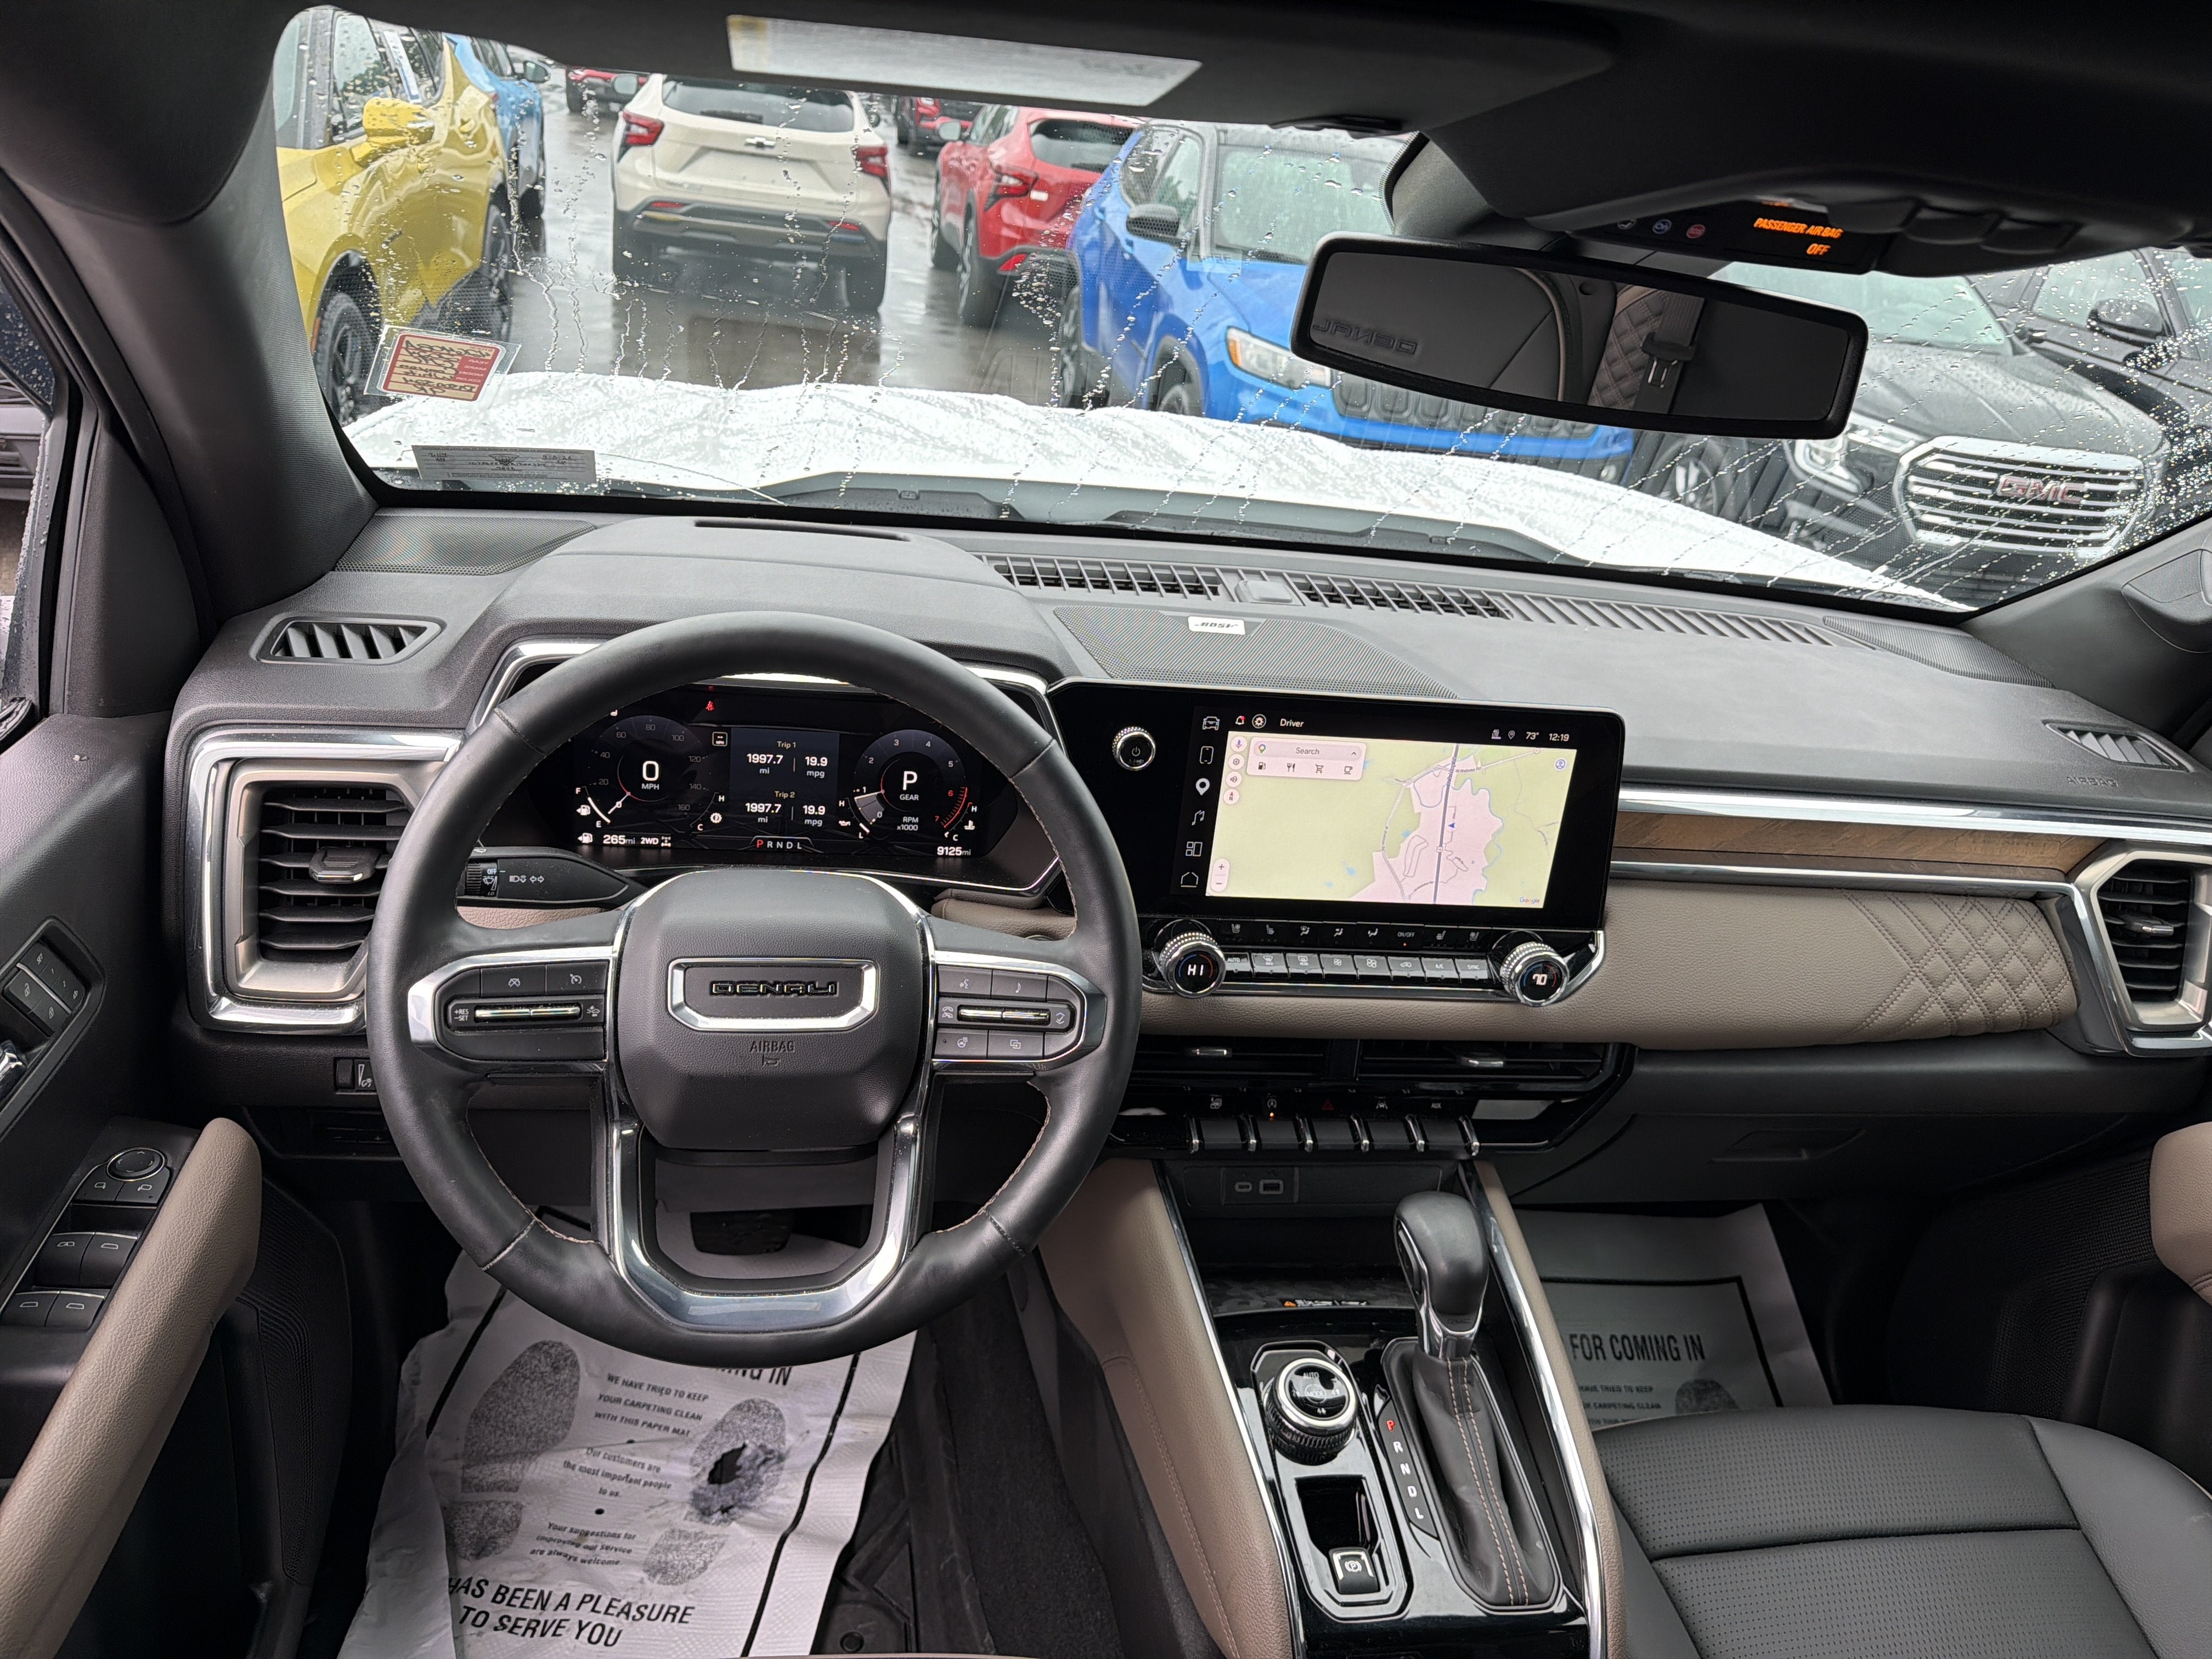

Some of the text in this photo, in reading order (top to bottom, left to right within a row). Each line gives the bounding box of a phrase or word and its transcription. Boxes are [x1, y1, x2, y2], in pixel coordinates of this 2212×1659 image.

[1754, 218, 1808, 233] PASSENGER
[1807, 243, 1831, 256] OFF
[1997, 476, 2089, 503] GMC
[1280, 718, 1304, 728] Driver
[1526, 731, 1539, 740] 73°
[1549, 733, 1570, 742] 12:19
[1295, 747, 1320, 755] Search
[747, 753, 783, 764] 1997.7
[805, 757, 828, 766] 19.9
[642, 761, 659, 781] 0
[806, 770, 825, 778] mpg
[902, 771, 918, 791] P
[2067, 776, 2119, 787] AIRBAG
[774, 791, 788, 799] Trip
[745, 803, 782, 813] 1997.7
[803, 805, 826, 815] 19.9
[804, 819, 823, 827] mpg
[757, 839, 763, 848] P
[1187, 964, 1204, 975] HI
[1532, 974, 1547, 985] 70
[710, 981, 838, 996] DENALI
[749, 1041, 795, 1053] AIRBAG
[1570, 1333, 1705, 1361] FOR COMING IN
[769, 1367, 793, 1386] IN
[607, 1373, 709, 1402] WE HAVE TRIED TO KEEP
[597, 1393, 703, 1421] YOUR CARPETING CLEAN
[594, 1412, 691, 1437] WITH THIS PAPER MAT
[1386, 1420, 1395, 1431] P
[1393, 1441, 1403, 1453] R
[586, 1447, 662, 1473] Our customers are
[563, 1460, 672, 1490] the most important people
[1400, 1463, 1411, 1475] N
[598, 1487, 607, 1495] to
[1407, 1486, 1417, 1497] D
[1415, 1508, 1424, 1519] L
[548, 1522, 636, 1541] Your suggestions for
[536, 1534, 582, 1548] improving
[600, 1544, 633, 1554] service
[547, 1549, 578, 1562] always
[449, 1577, 695, 1624] HAS BEEN A PLEASURE
[459, 1605, 623, 1646] TO SERVE YOU
